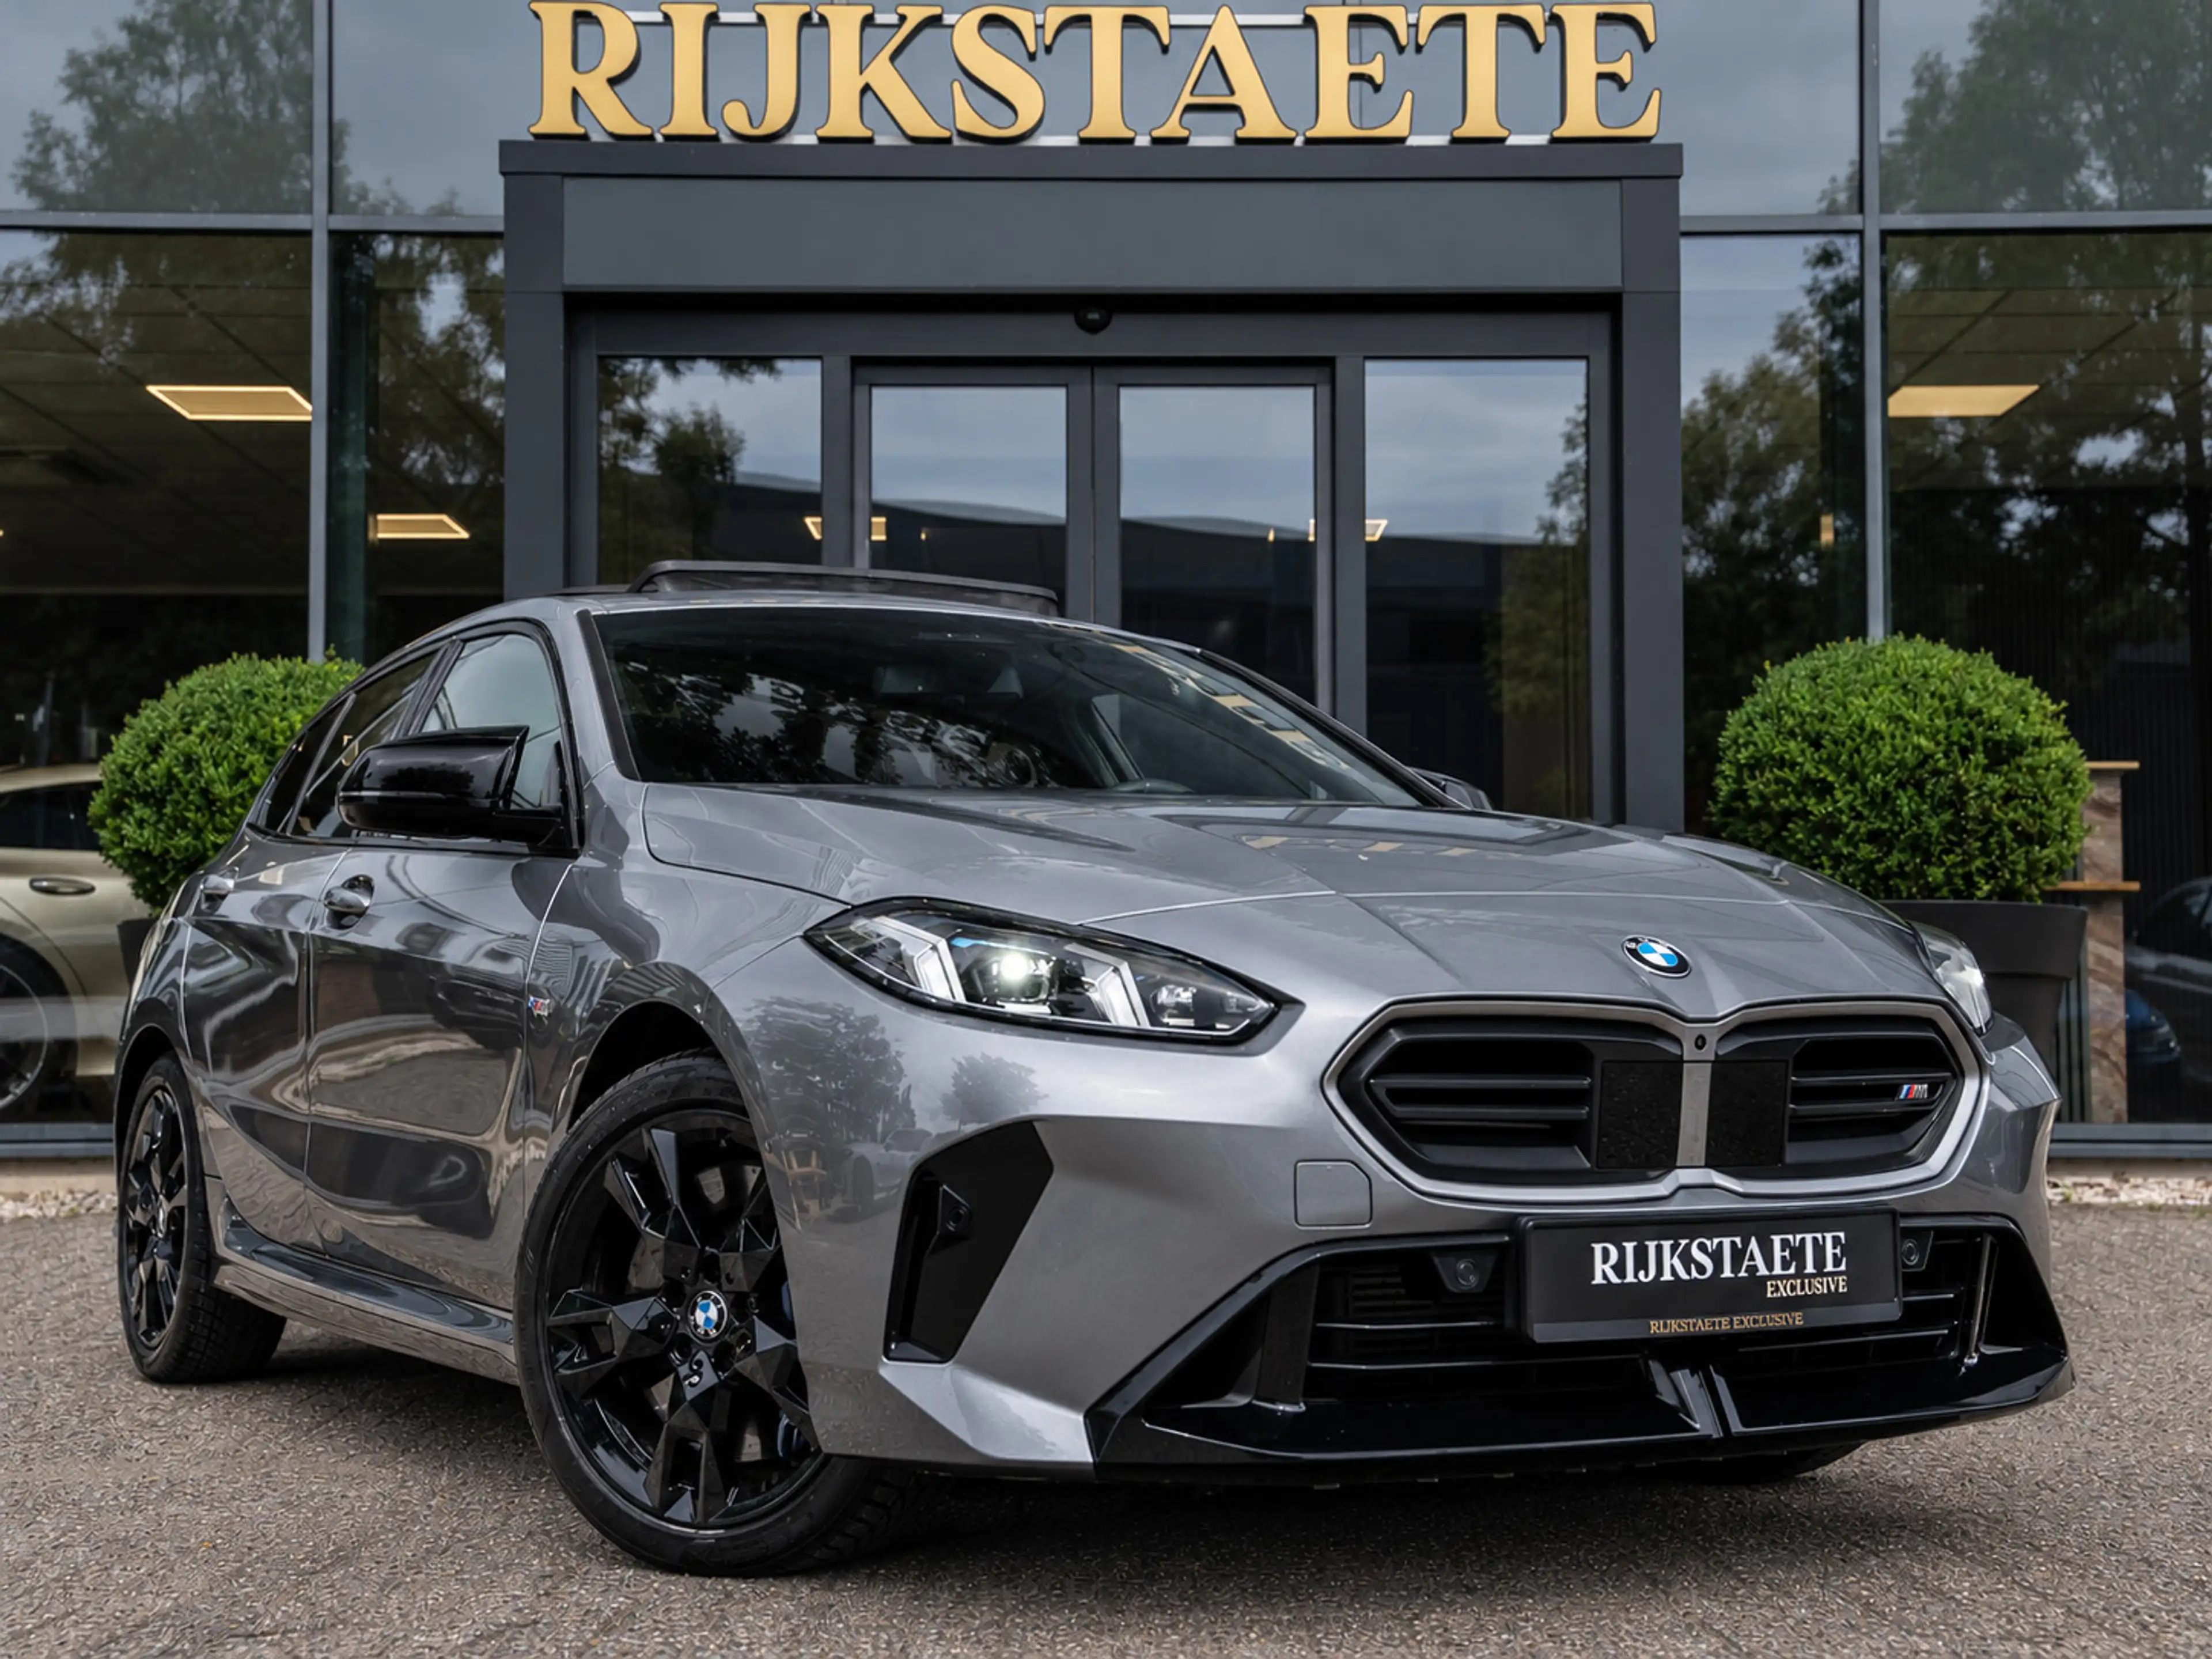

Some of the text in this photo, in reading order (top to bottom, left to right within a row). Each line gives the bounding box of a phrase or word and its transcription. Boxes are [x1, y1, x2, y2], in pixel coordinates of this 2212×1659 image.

[528, 1, 1661, 143] RIJKSTAETE
[1590, 1232, 1846, 1284] RIJKSTAETE
[1766, 1275, 1848, 1298] EXCLUSIVE
[1649, 1312, 1804, 1334] RIJKSTAETE EXCLUSIVE
